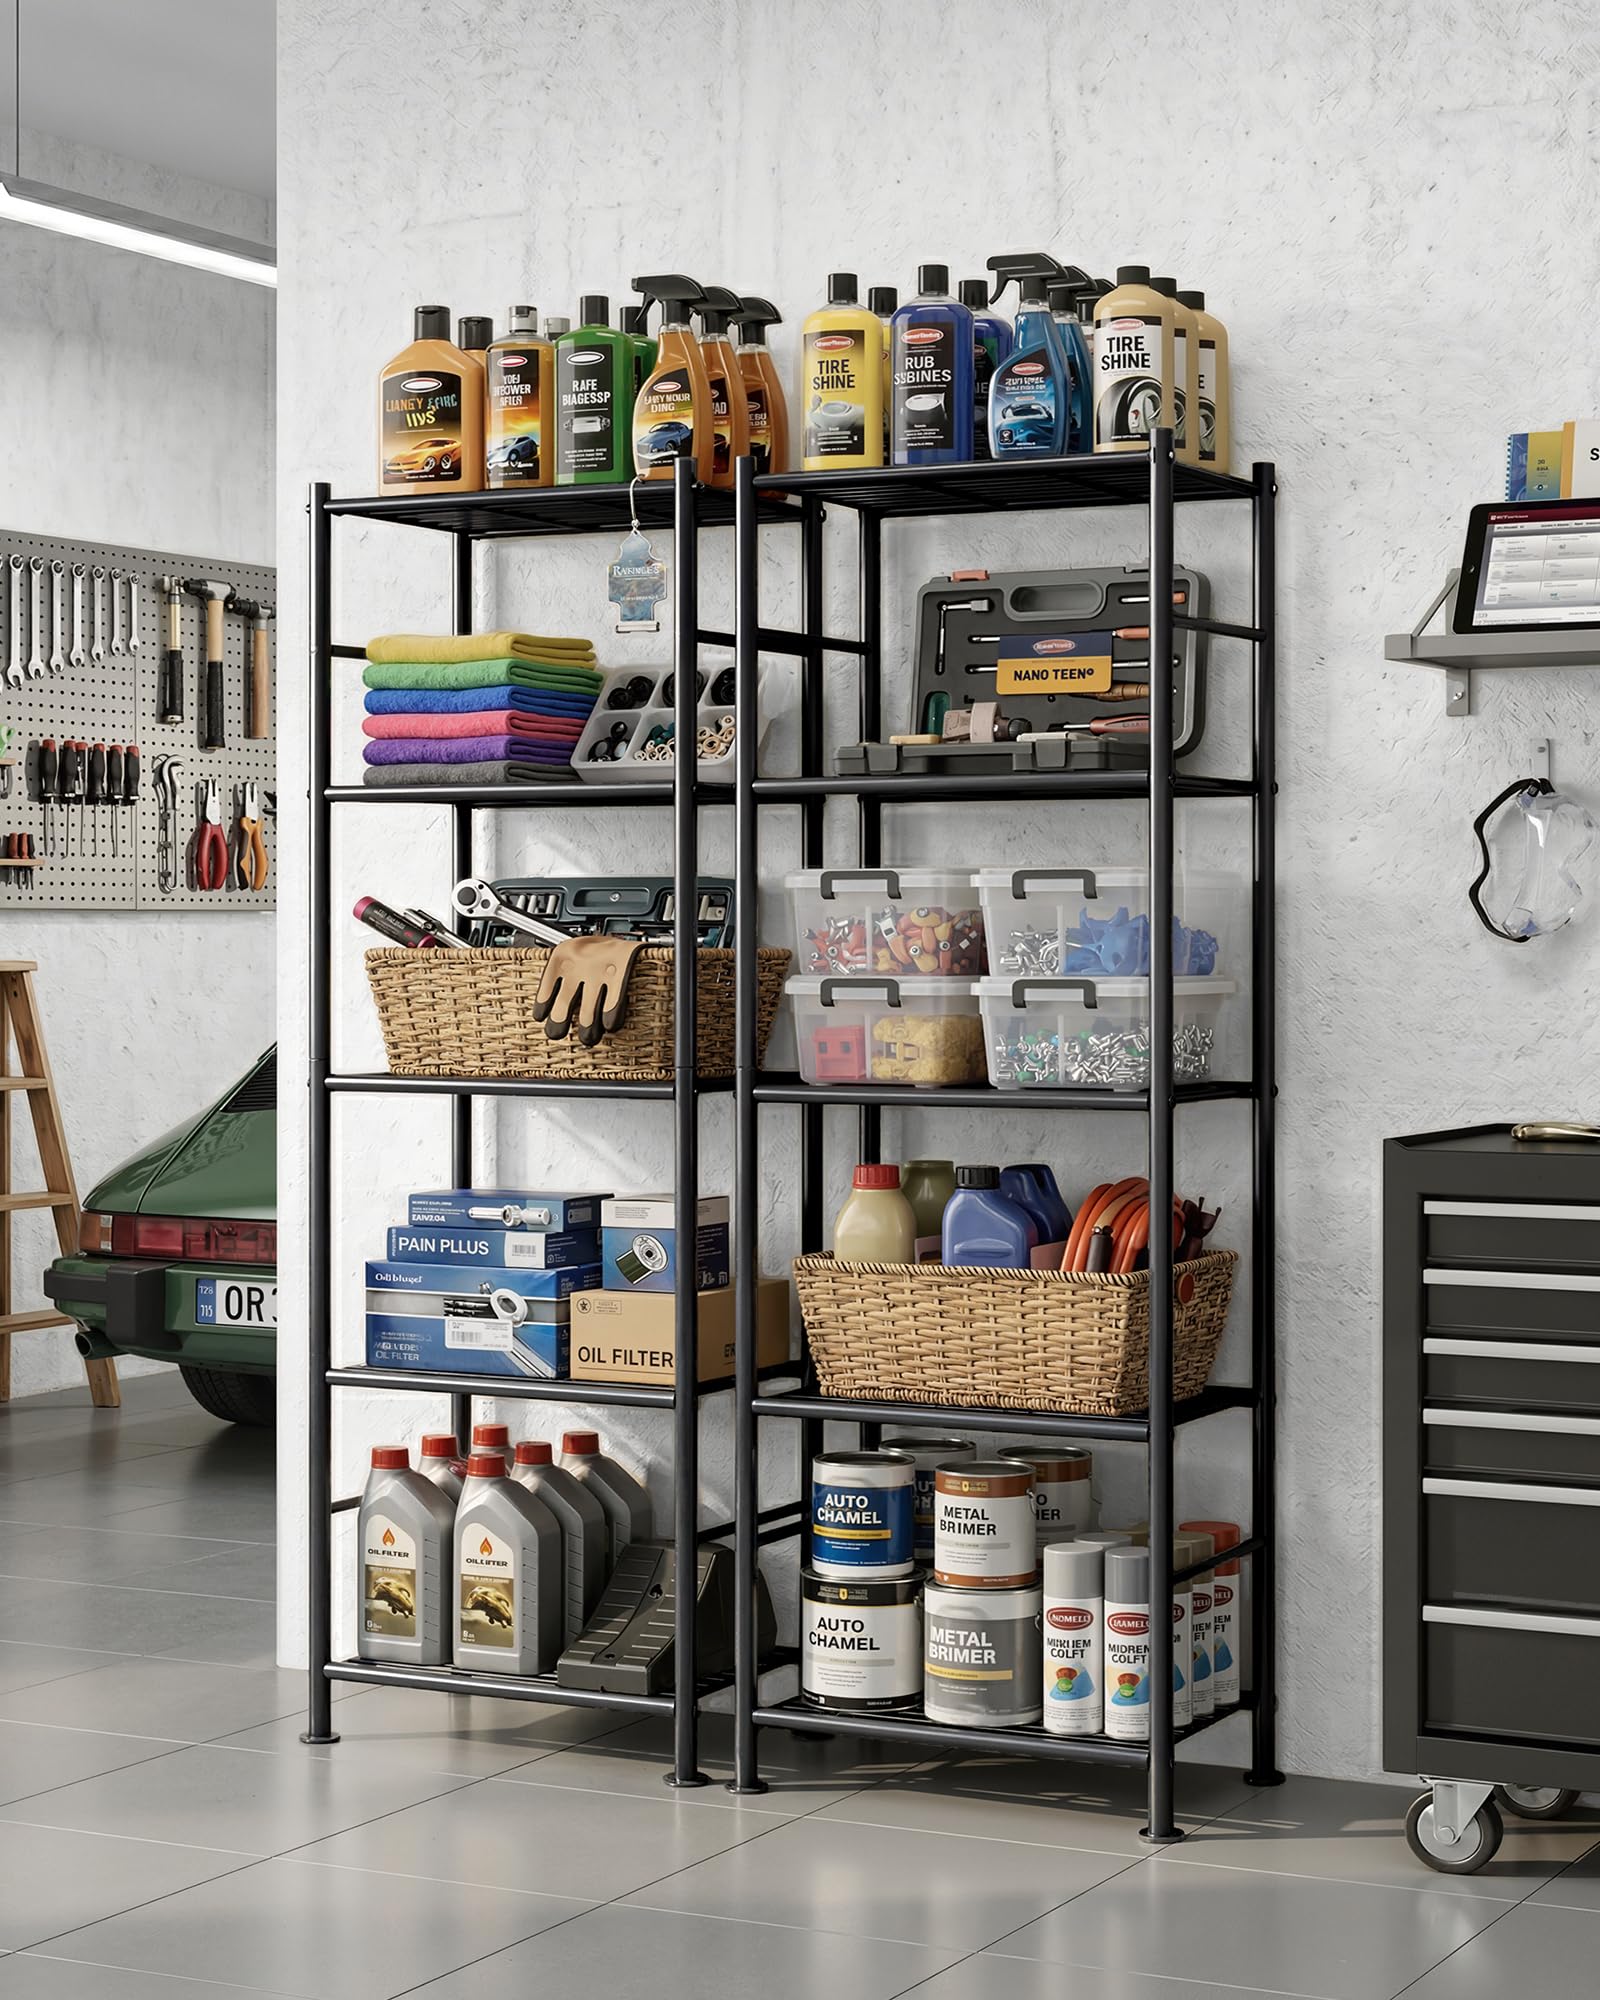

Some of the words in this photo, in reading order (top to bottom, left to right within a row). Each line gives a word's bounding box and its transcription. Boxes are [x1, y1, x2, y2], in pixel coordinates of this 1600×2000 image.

[1106, 335, 1145, 353] TIRE
[817, 359, 850, 375] TIRE
[904, 355, 935, 370] RUB
[1101, 353, 1151, 371] SHINE
[572, 378, 598, 392] RAFE
[813, 374, 856, 391] SHINE
[651, 402, 675, 413] DING
[1012, 668, 1050, 682] NANO
[398, 1236, 437, 1254] PAIN
[577, 1346, 607, 1364] OIL
[612, 1348, 674, 1369] FILTER
[824, 1493, 869, 1509] AUTO
[817, 1508, 882, 1525] CHAMEL
[943, 1505, 990, 1522] METAL
[382, 1549, 409, 1558] FILTER
[816, 1617, 865, 1633] AUTO
[809, 1632, 881, 1652] CHAMEL
[929, 1626, 993, 1647] METAL
[928, 1645, 997, 1665] BRIMER
[1050, 1648, 1085, 1659] COLFT
[1111, 1653, 1147, 1664] COLFT
